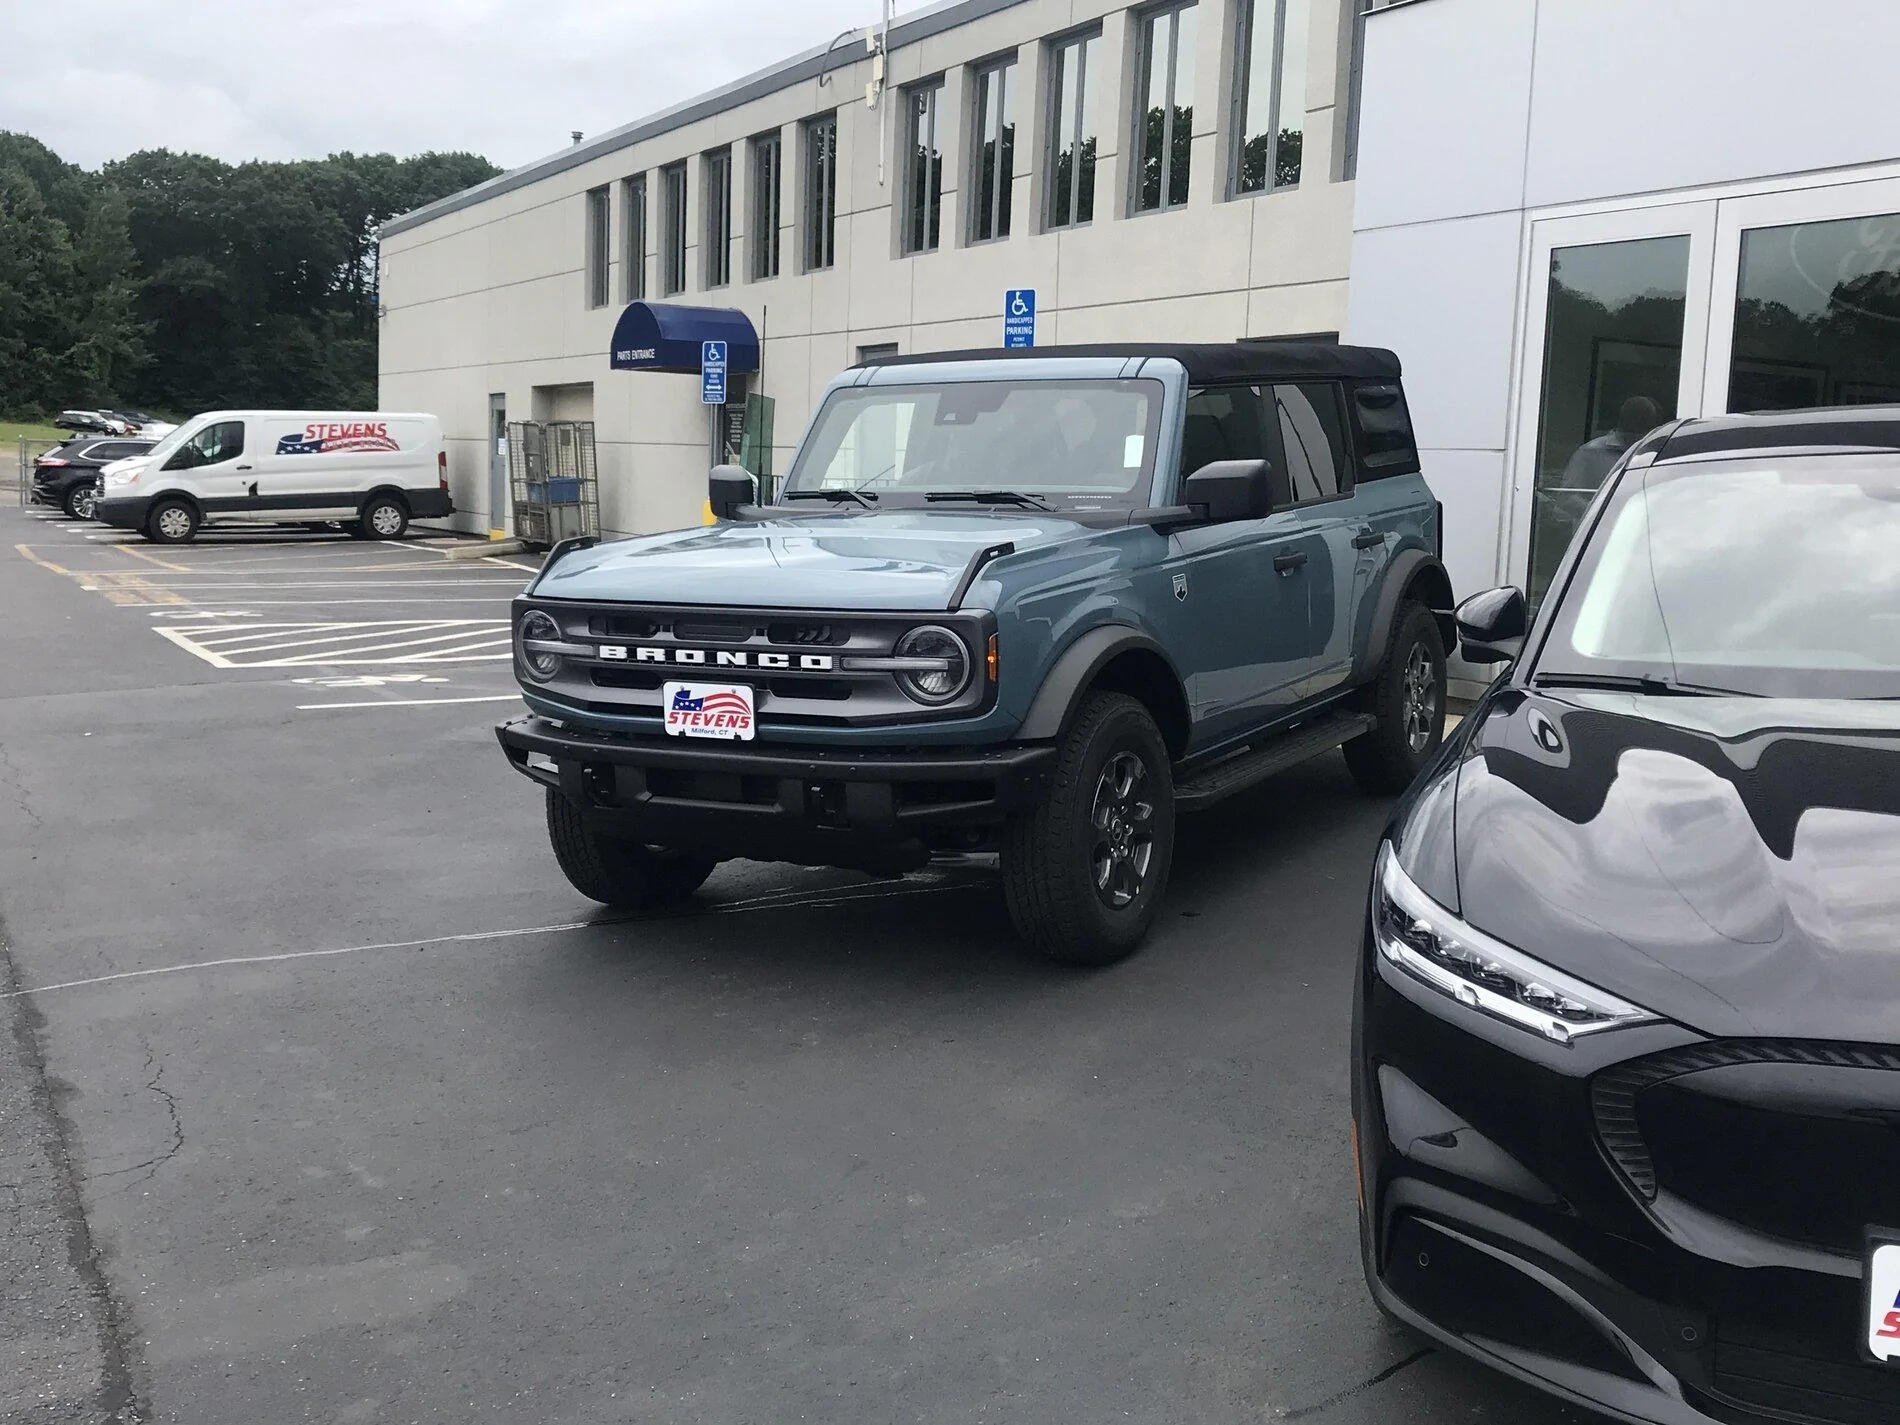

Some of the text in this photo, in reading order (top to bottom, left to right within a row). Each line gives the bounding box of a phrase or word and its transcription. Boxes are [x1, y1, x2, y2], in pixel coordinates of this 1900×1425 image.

[1006, 326, 1033, 335] PARKING
[617, 348, 655, 360] PARTS ENTRANCE
[304, 422, 388, 440] STEVENS
[599, 645, 833, 670] BRONCO
[667, 711, 752, 729] STEVENS
[690, 727, 717, 736] Milford,
